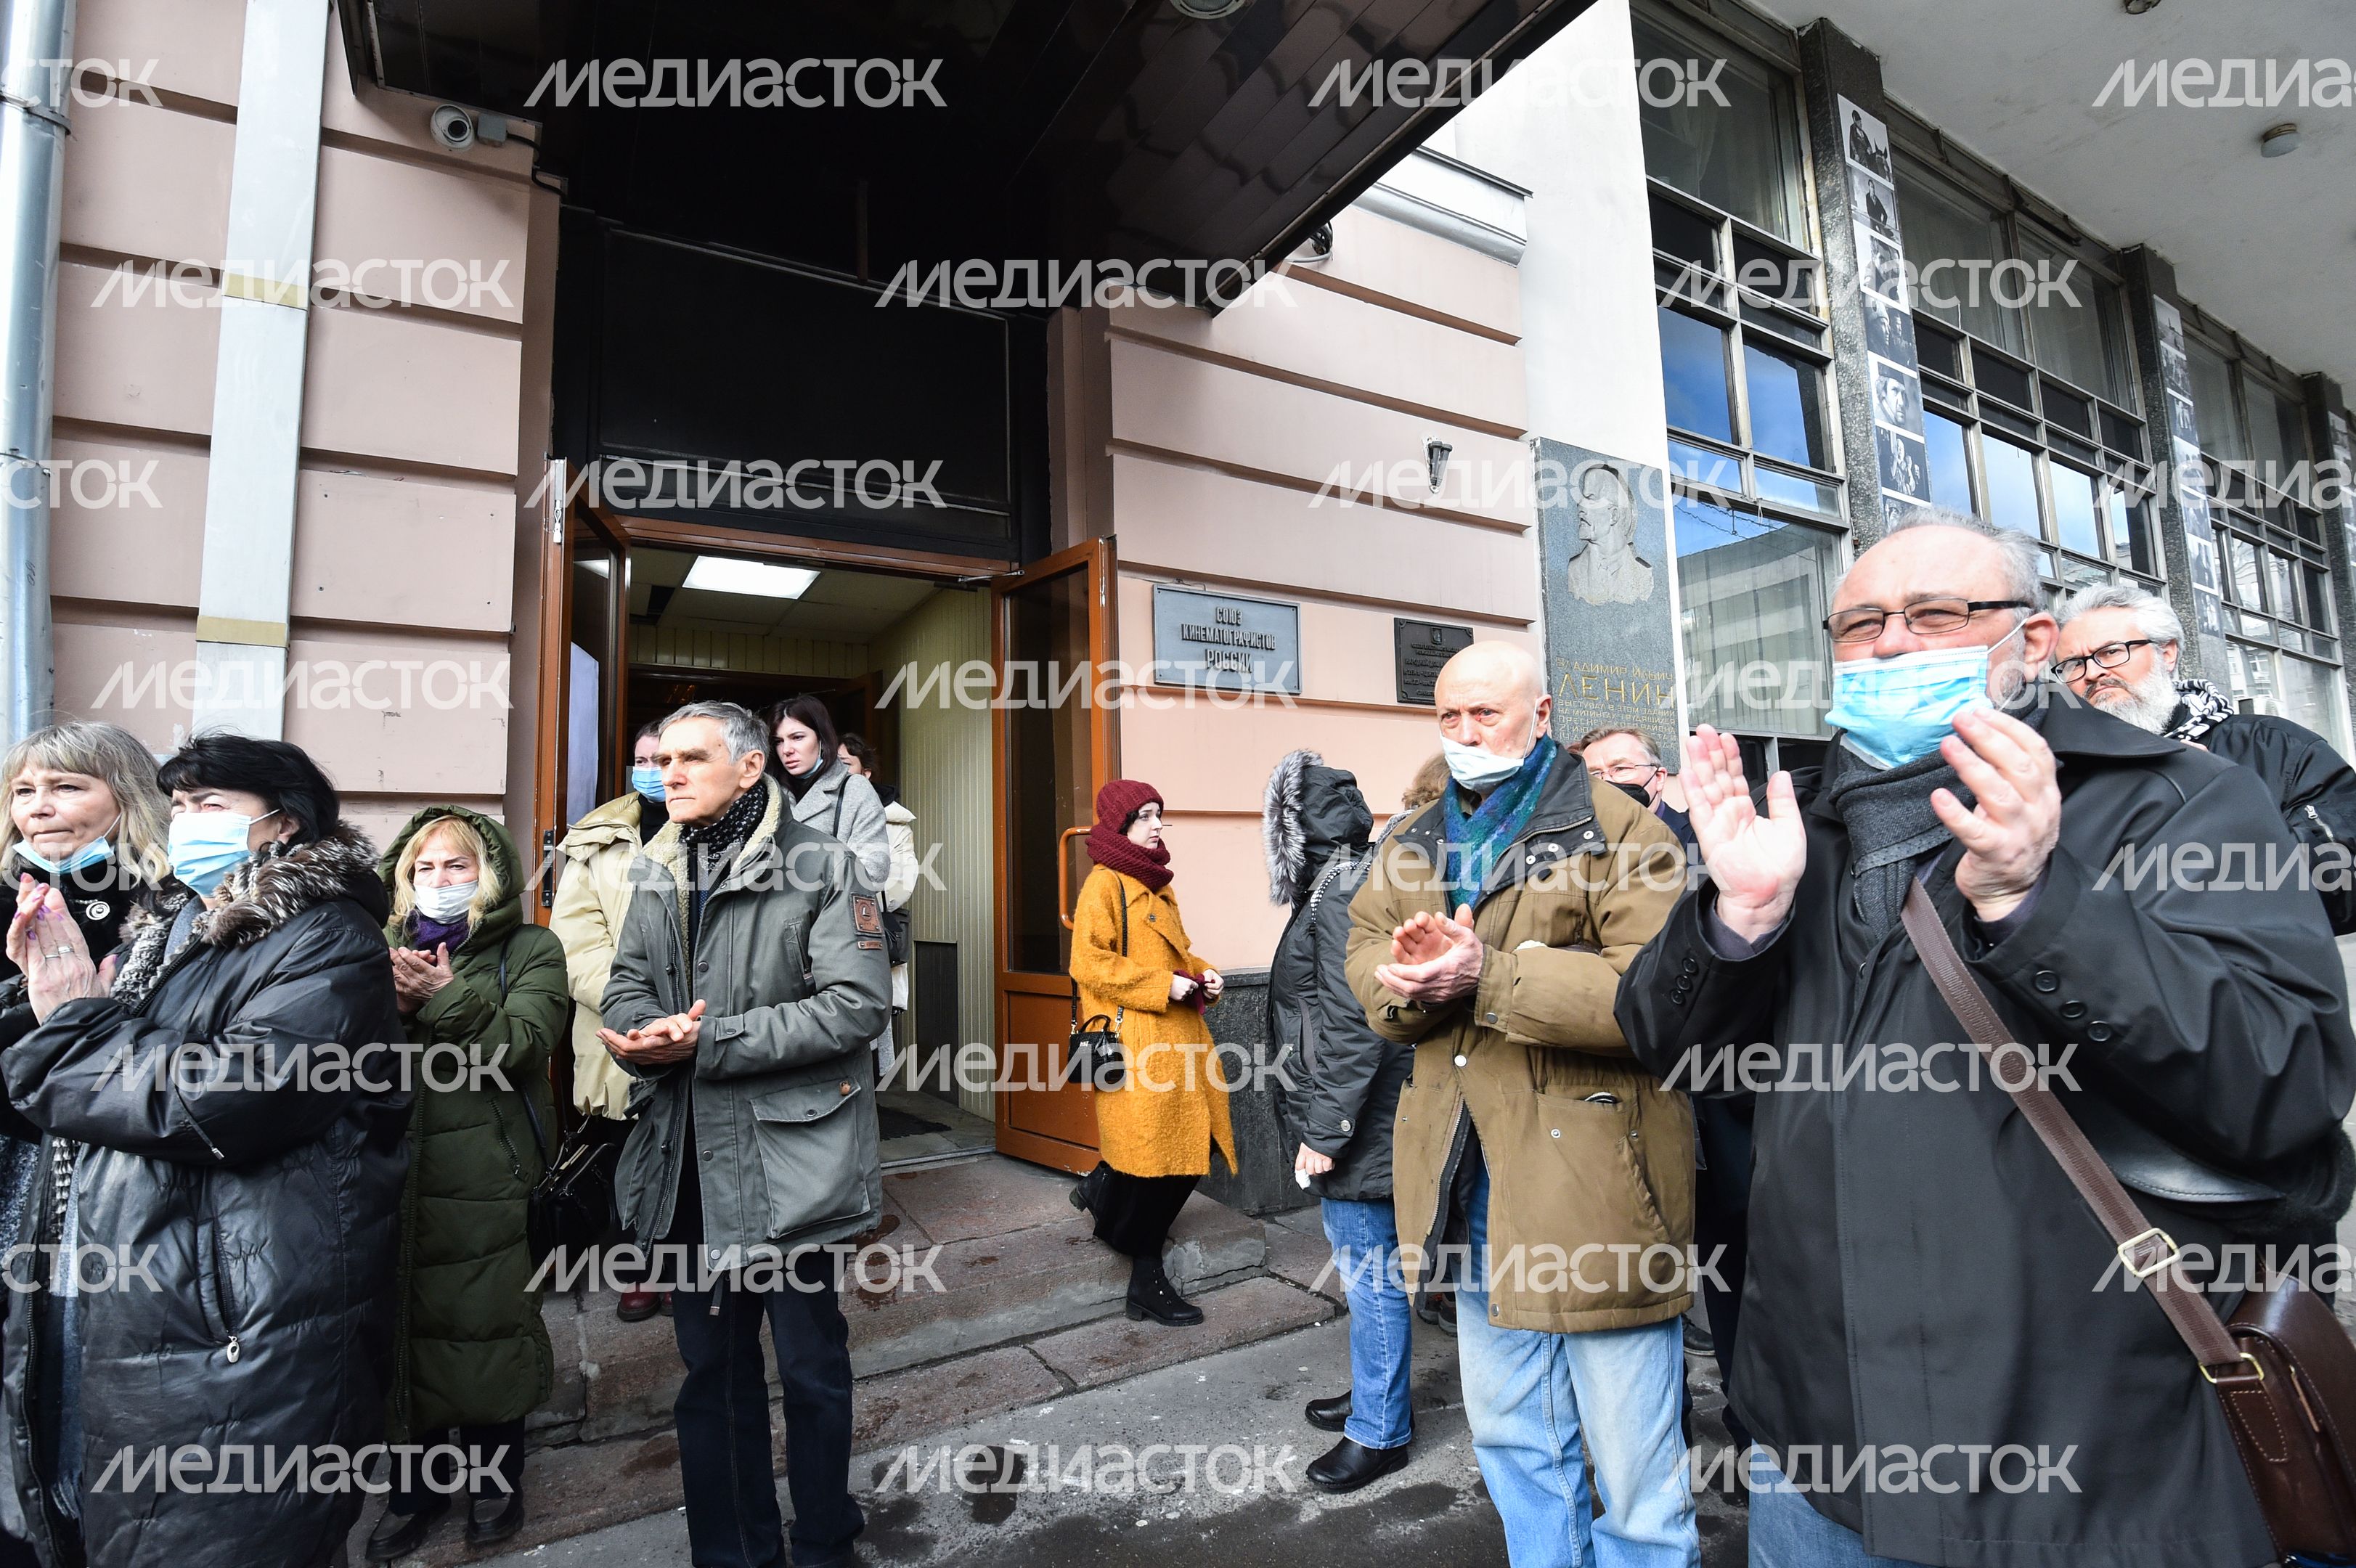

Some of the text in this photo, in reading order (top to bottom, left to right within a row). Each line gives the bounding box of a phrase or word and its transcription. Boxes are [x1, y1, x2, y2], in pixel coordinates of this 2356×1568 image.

[1216, 607, 1243, 625] СОЮЗ
[1181, 624, 1276, 650] КИНЕМАТОГРАФИСТОВ
[1205, 649, 1252, 674] РОССИИ
[1556, 657, 1674, 681] ВЛАДИМИР ИЛЬИЧ
[1559, 673, 1674, 709] ЛЕНИН
[1558, 699, 1606, 711] ВЫСТУПАЛ
[1618, 705, 1639, 714] ЭТОМ
[1642, 707, 1675, 716] ЗДАНИИ
[1573, 709, 1616, 719] МИТИНГАХ
